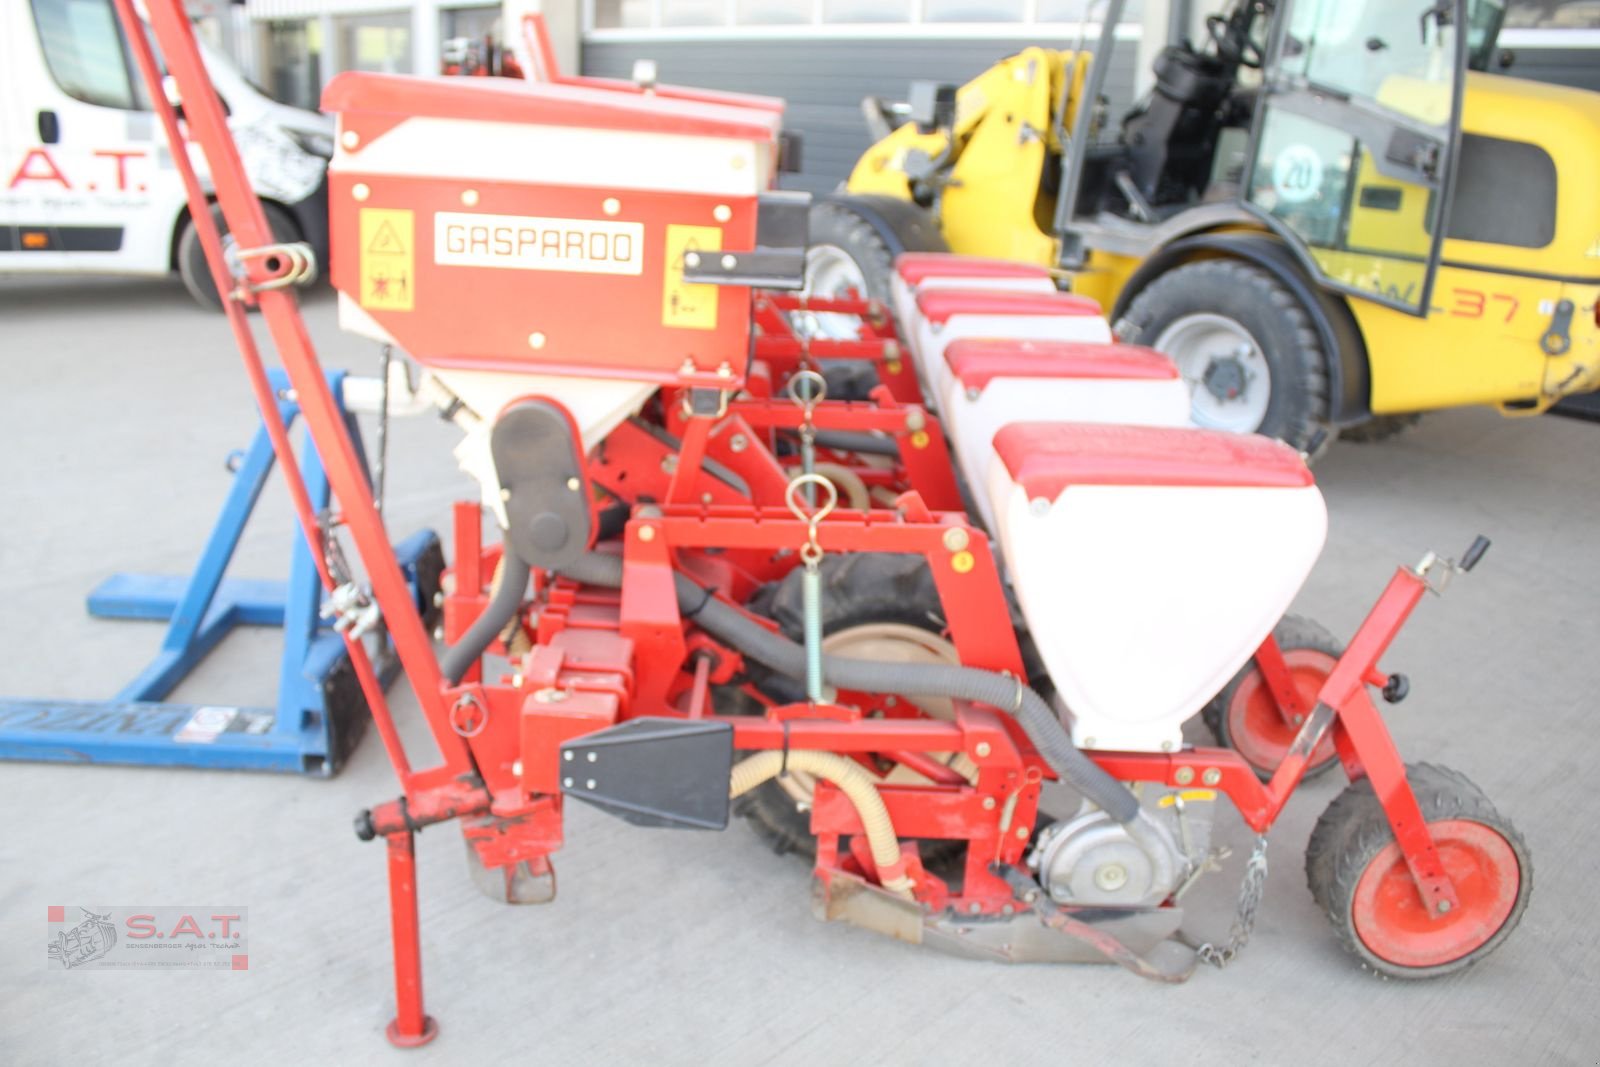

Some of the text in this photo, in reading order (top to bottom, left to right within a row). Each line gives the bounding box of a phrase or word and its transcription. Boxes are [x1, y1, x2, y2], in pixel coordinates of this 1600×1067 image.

[1281, 156, 1312, 190] 20
[447, 224, 632, 262] GASPARDO
[1450, 287, 1520, 323] 37
